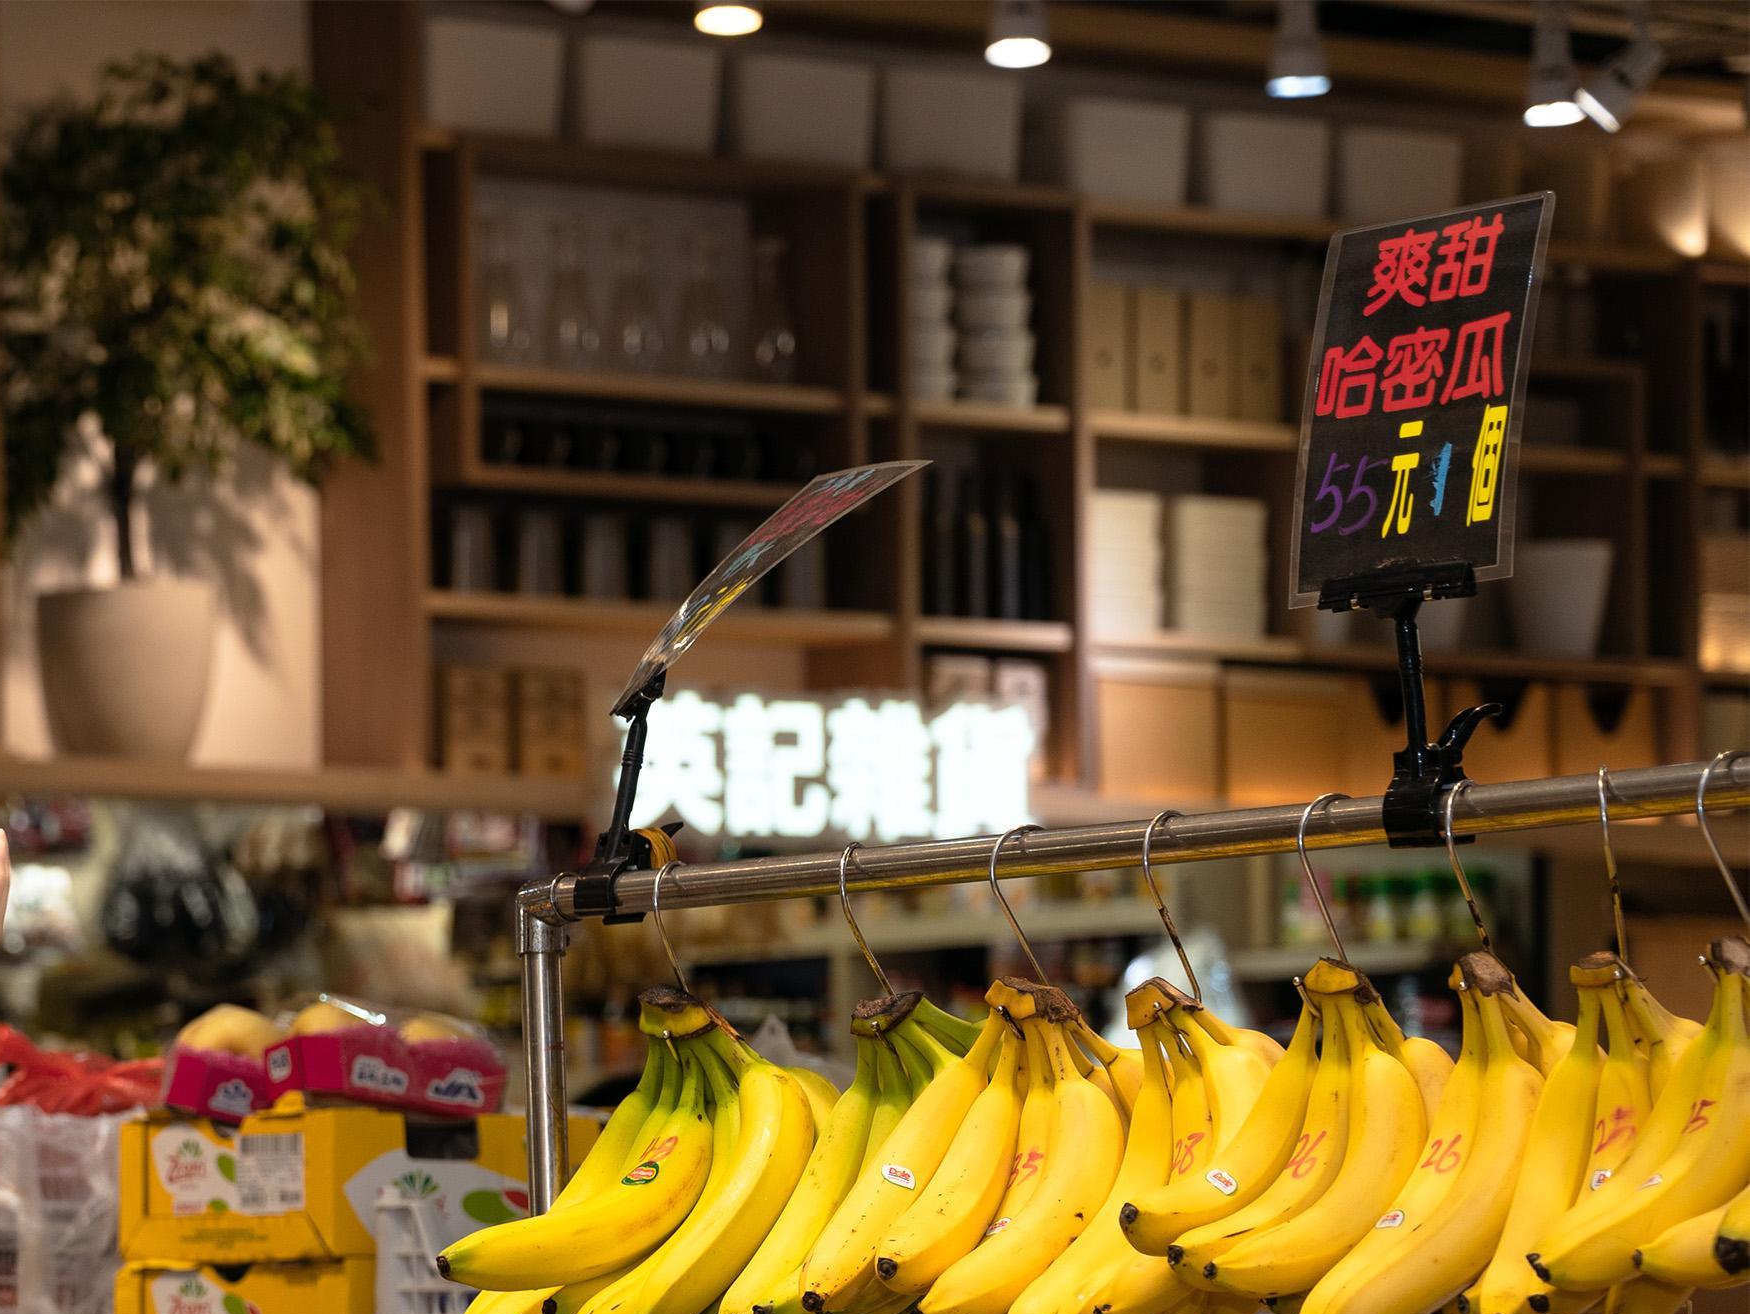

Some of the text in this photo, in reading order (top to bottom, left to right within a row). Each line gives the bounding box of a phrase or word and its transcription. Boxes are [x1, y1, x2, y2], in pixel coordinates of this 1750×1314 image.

[1362, 212, 1505, 317] 爽甜
[1314, 311, 1512, 420] 哈密瓜
[888, 1167, 912, 1181] Dole
[1421, 1133, 1462, 1173] 26
